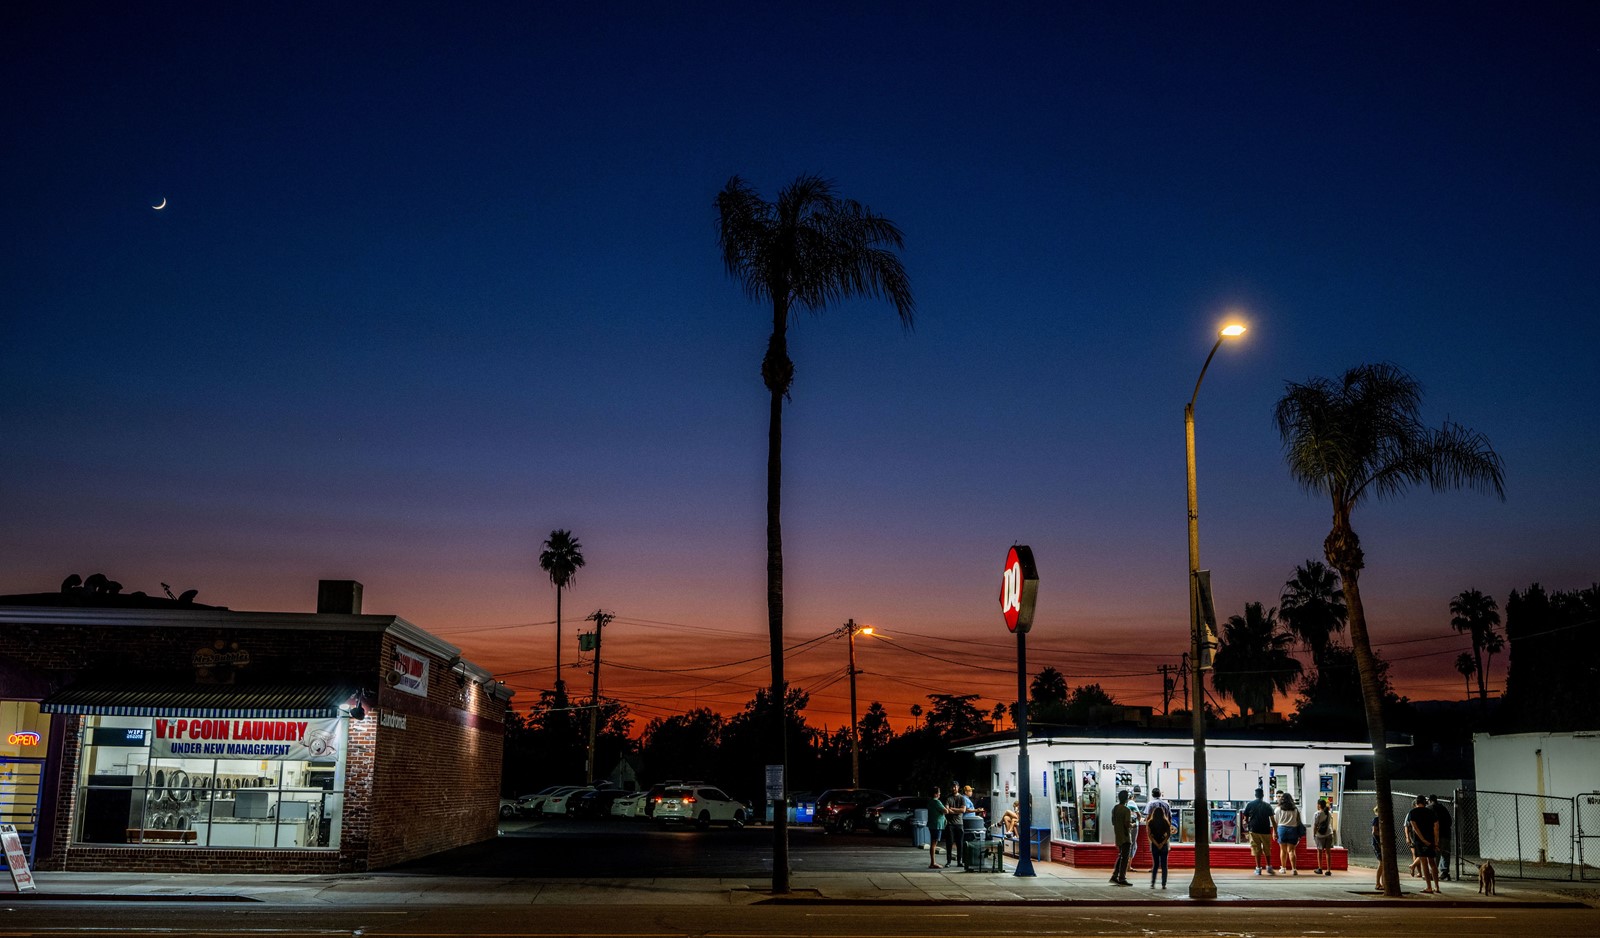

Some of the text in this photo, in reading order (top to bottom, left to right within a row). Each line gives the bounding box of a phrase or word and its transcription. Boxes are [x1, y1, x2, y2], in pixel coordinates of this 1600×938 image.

[1003, 561, 1021, 613] DQ
[379, 708, 407, 730] Laundromat
[188, 719, 229, 740] COIN
[231, 720, 308, 741] LAUNDRY
[8, 734, 38, 746] OPEN
[170, 742, 290, 756] UNDER NEW MANAGEMENT
[1102, 763, 1117, 771] 6665
